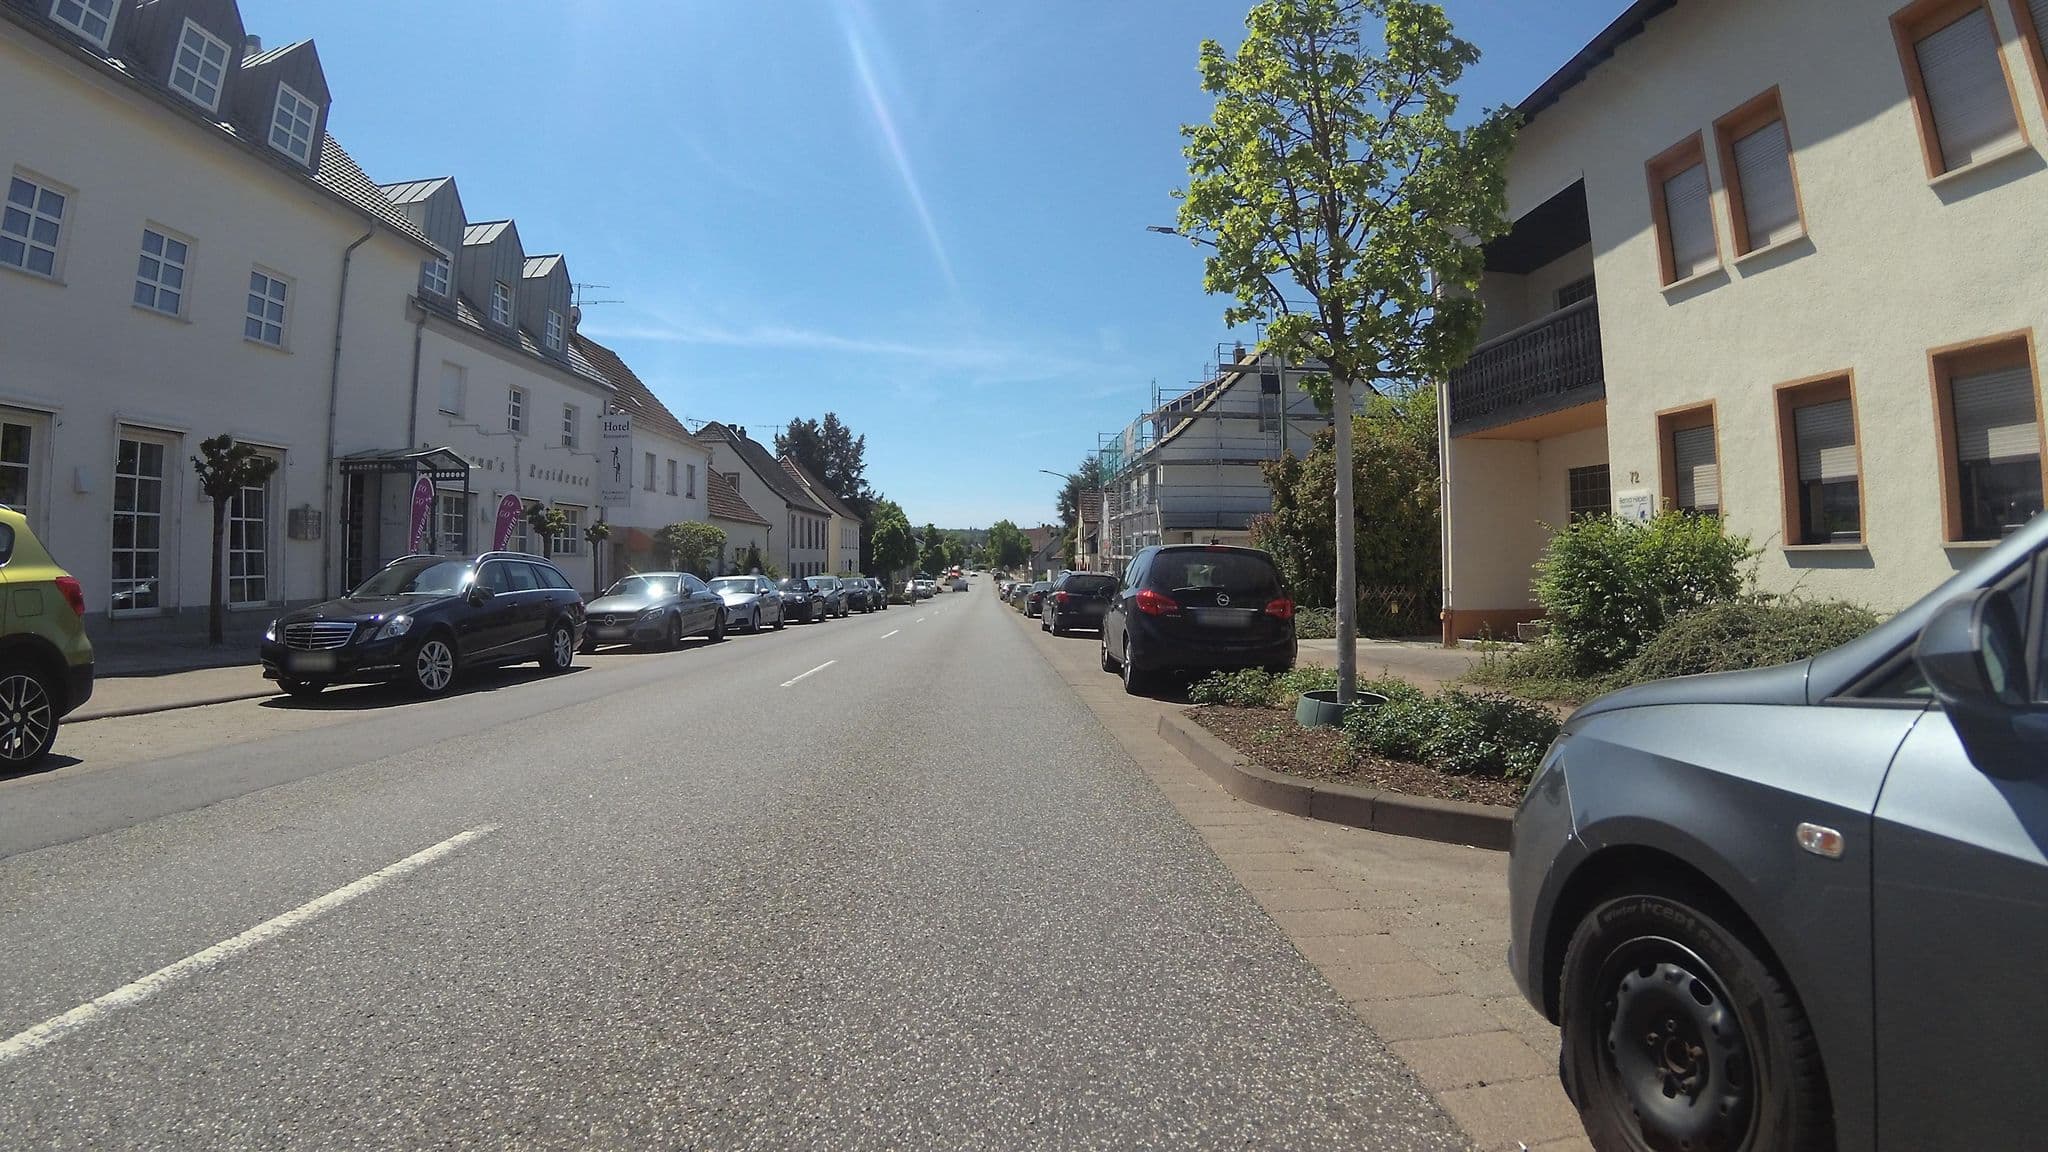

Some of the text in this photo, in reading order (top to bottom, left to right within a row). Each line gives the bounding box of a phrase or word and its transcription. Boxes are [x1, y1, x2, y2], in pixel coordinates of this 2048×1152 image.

[604, 420, 630, 432] Hotel
[529, 463, 590, 487] Residence
[1629, 471, 1641, 485] 72
